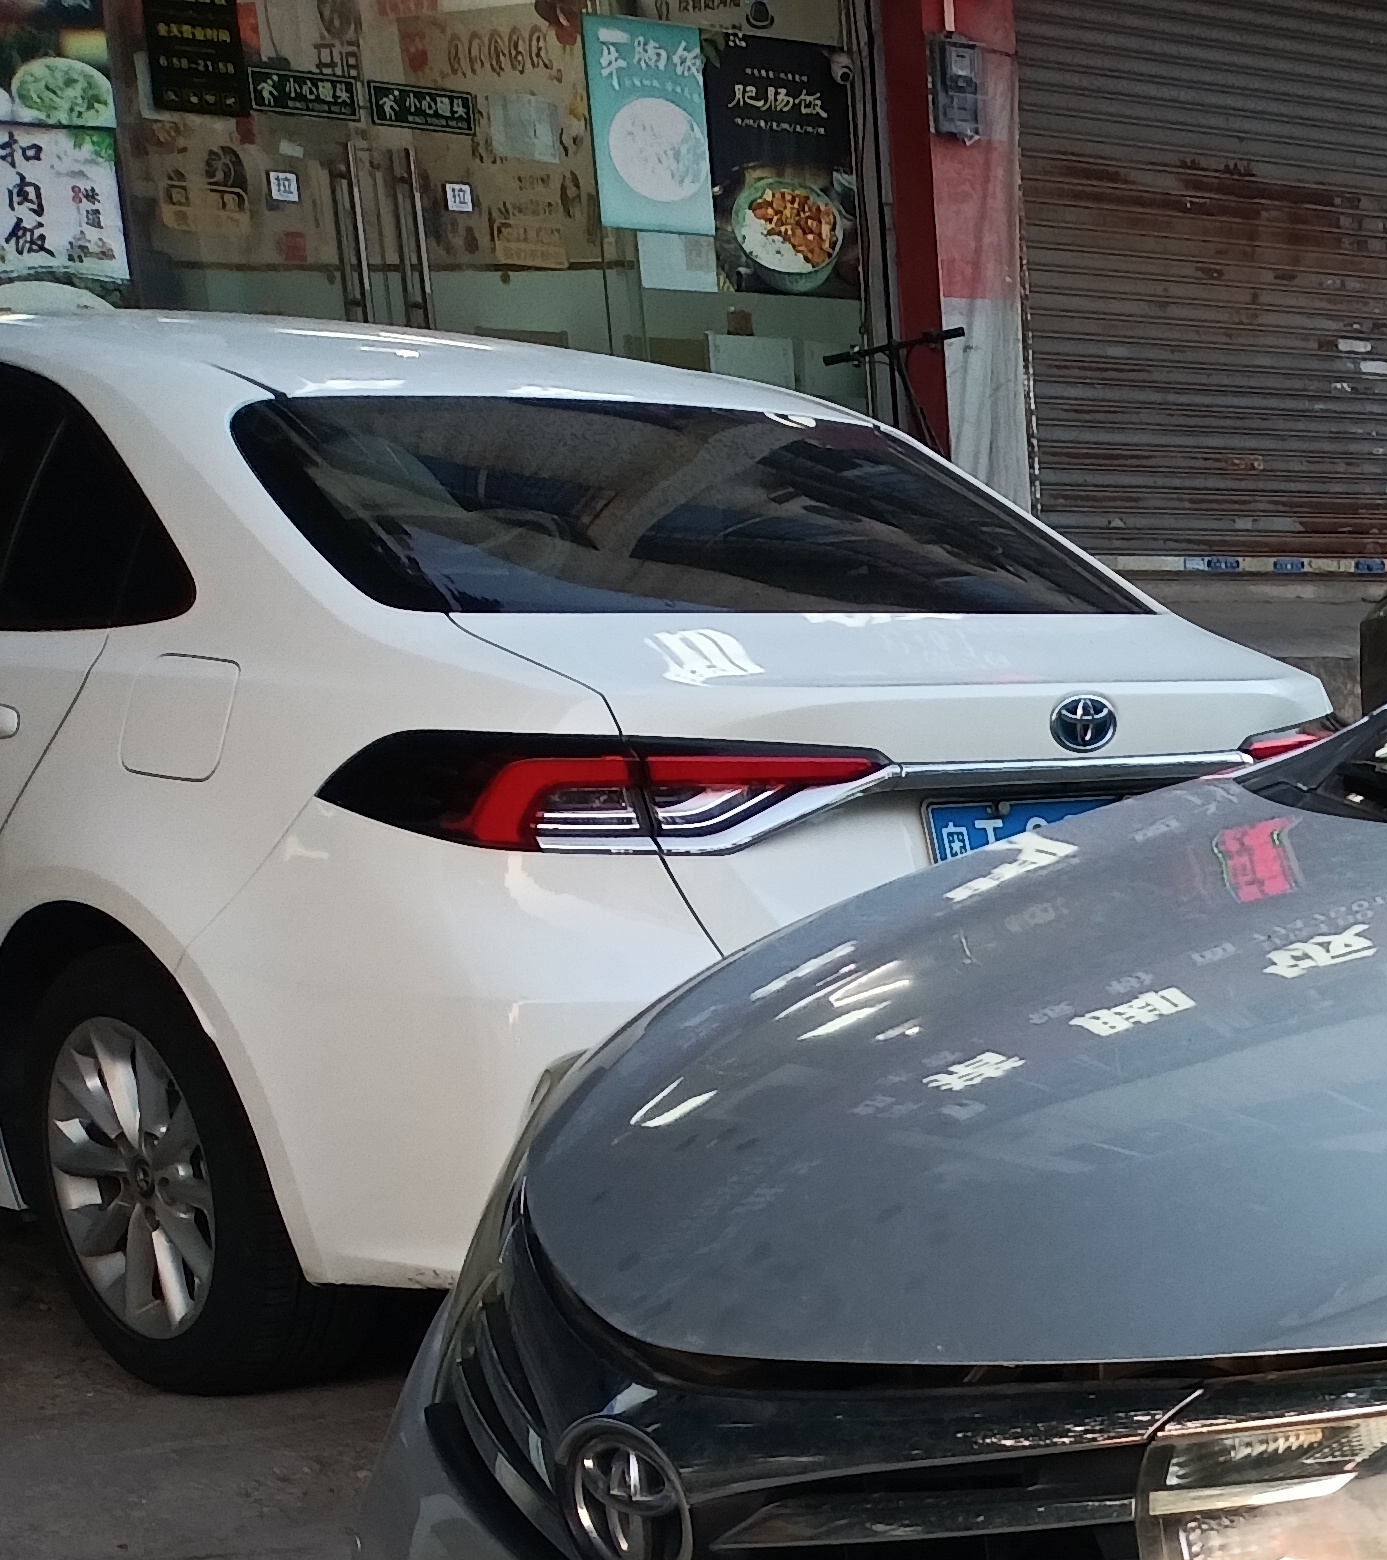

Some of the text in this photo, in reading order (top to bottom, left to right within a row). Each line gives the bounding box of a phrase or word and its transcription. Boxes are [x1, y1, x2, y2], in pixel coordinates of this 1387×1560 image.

[285, 77, 351, 104] 小心碰头
[727, 83, 829, 119] 肥肠饭
[405, 92, 468, 119] 小心碰头
[0, 130, 56, 258] 扣肉饭
[274, 174, 294, 195] 拉
[451, 186, 469, 207] 拉
